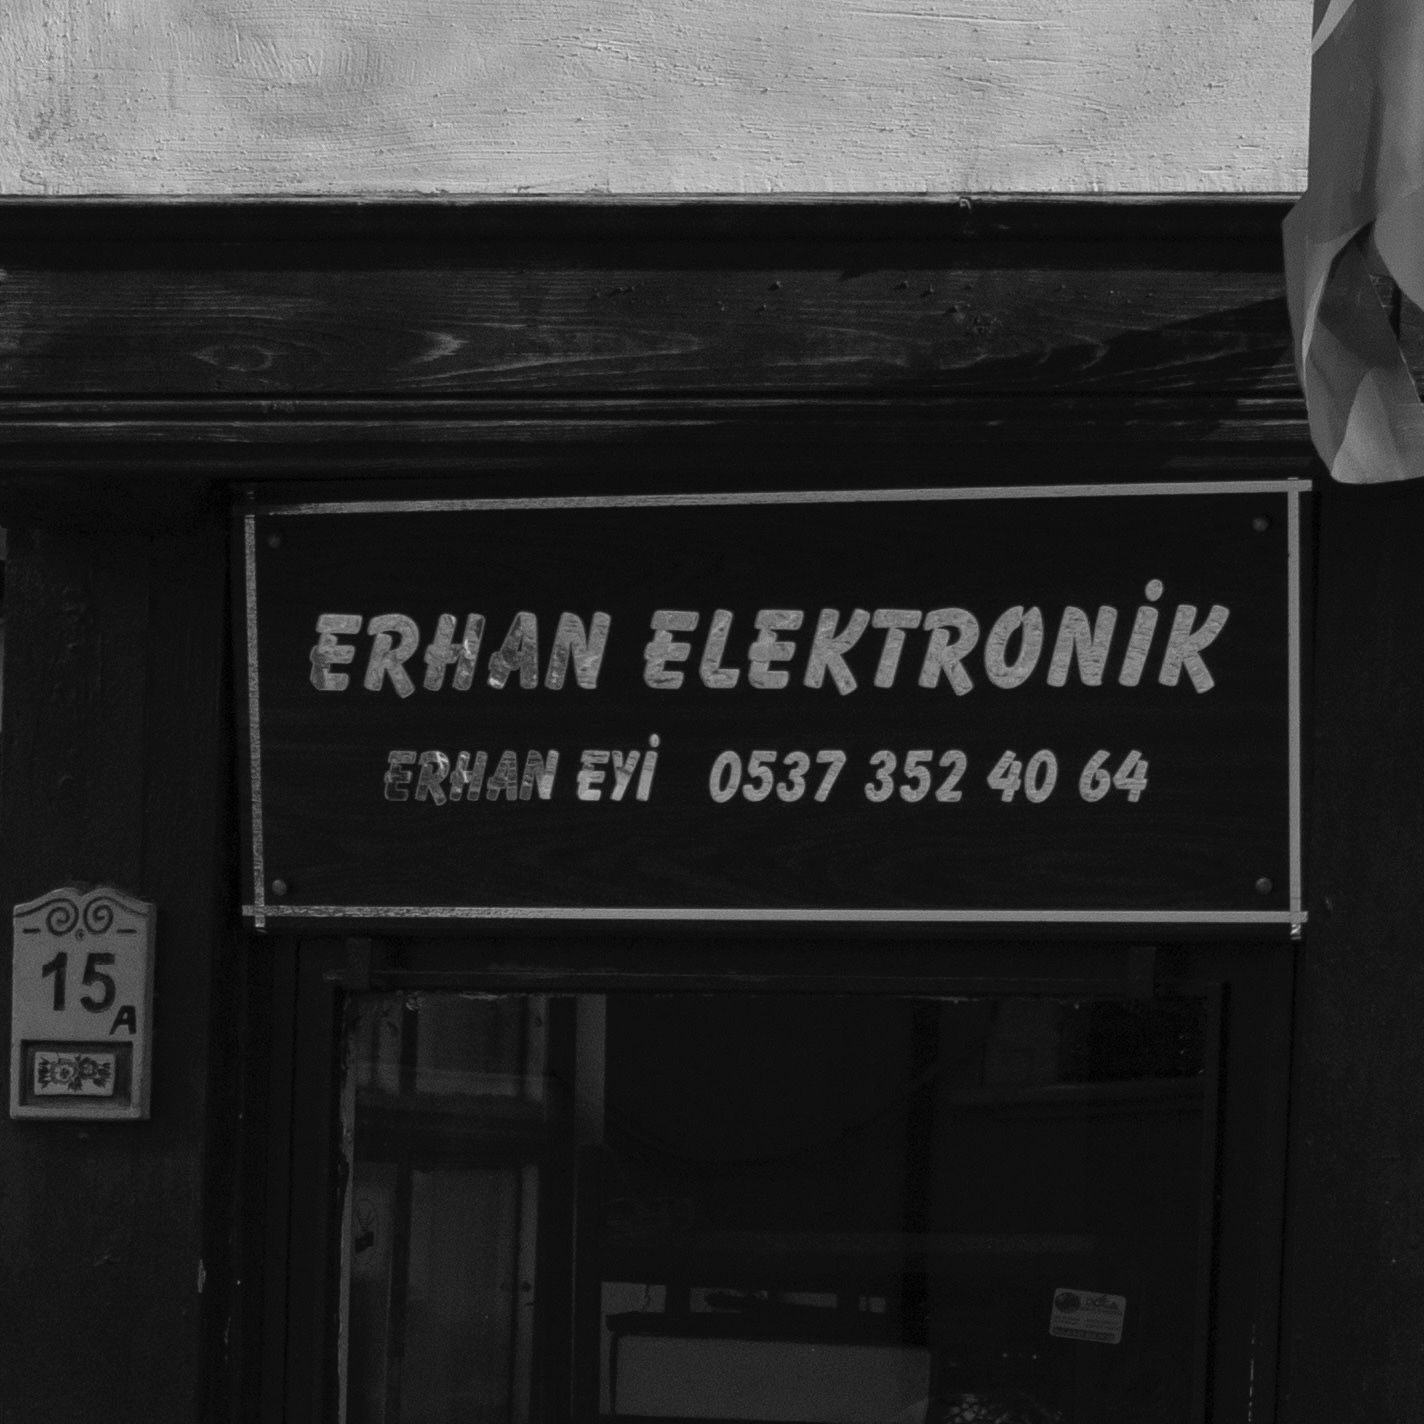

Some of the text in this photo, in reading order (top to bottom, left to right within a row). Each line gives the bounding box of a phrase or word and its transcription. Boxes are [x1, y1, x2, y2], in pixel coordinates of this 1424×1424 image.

[309, 578, 1230, 699] ERHAN ELEKTRONİK
[384, 733, 1149, 806] ERHAN EYİ 0537 352 40 64
[42, 952, 116, 1014] 15
[109, 1005, 136, 1034] A
